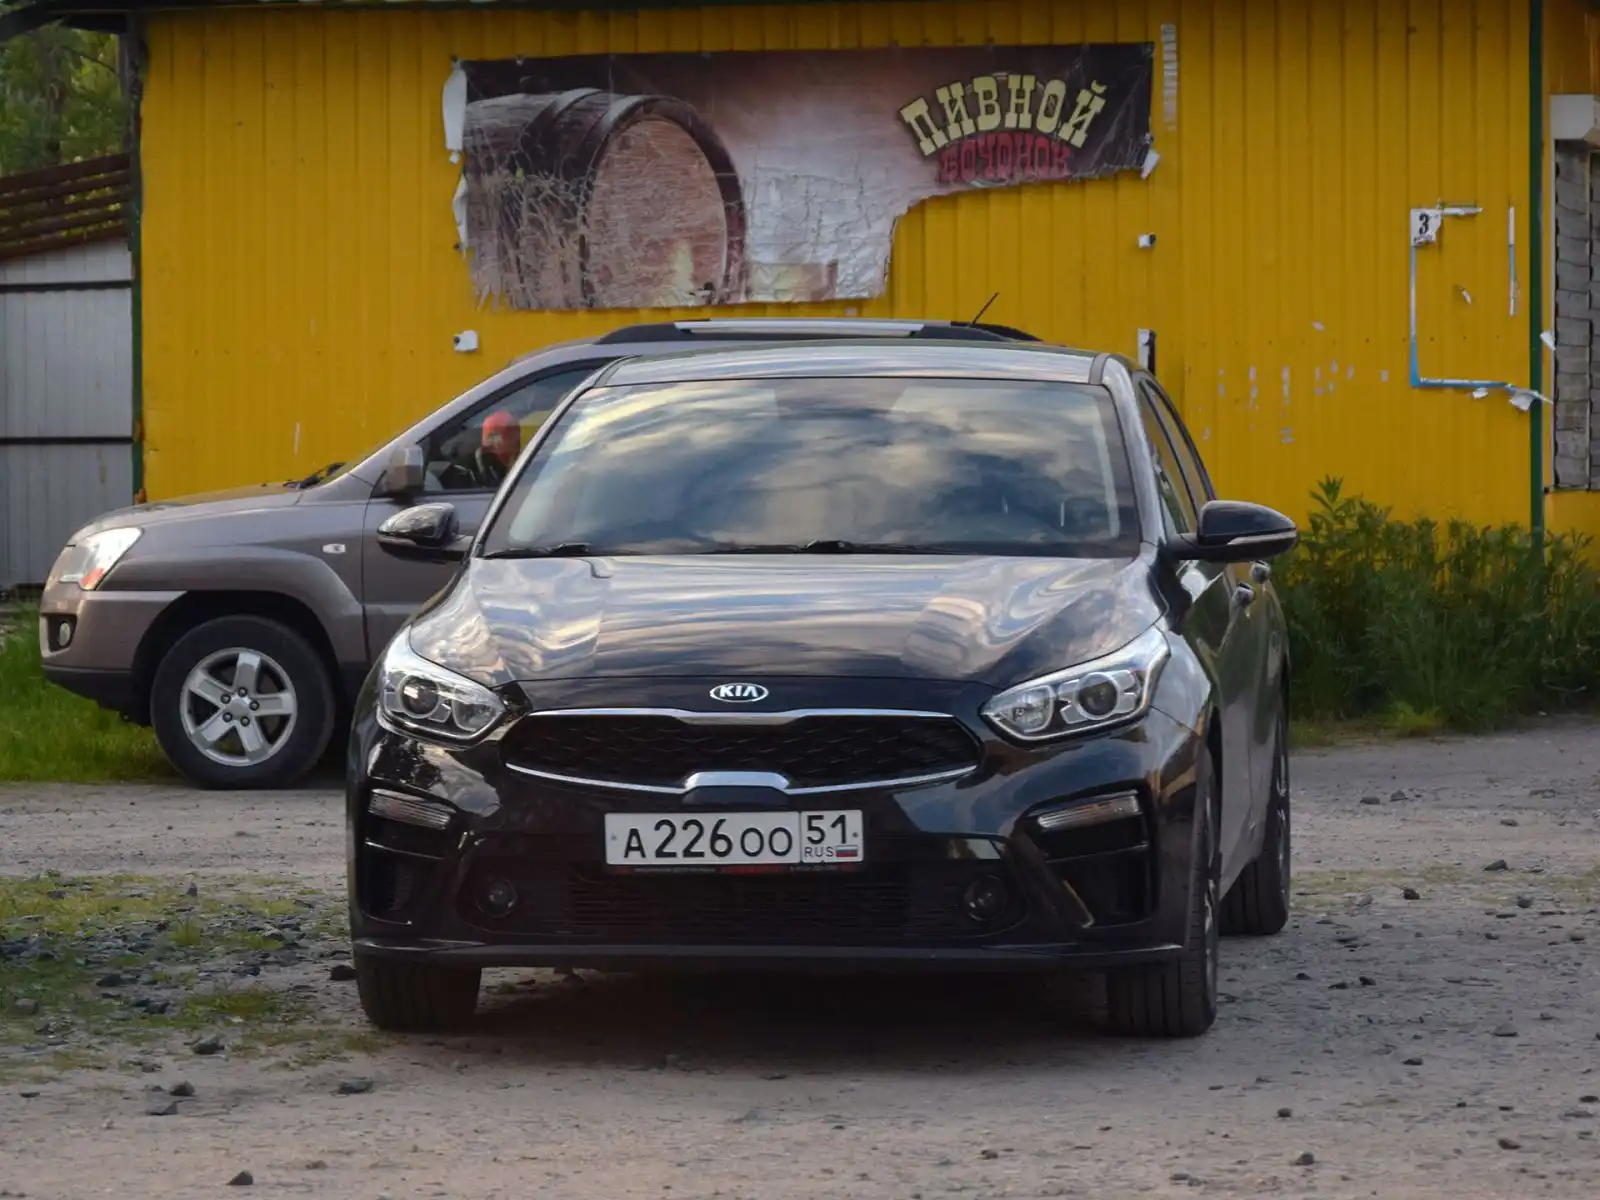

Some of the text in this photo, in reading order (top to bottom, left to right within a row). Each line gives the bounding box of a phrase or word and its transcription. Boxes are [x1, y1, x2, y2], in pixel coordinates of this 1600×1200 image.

[900, 74, 1108, 156] ПИВНОЙ
[719, 685, 759, 698] KIA
[806, 814, 848, 844] 51
[804, 846, 835, 858] RUS
